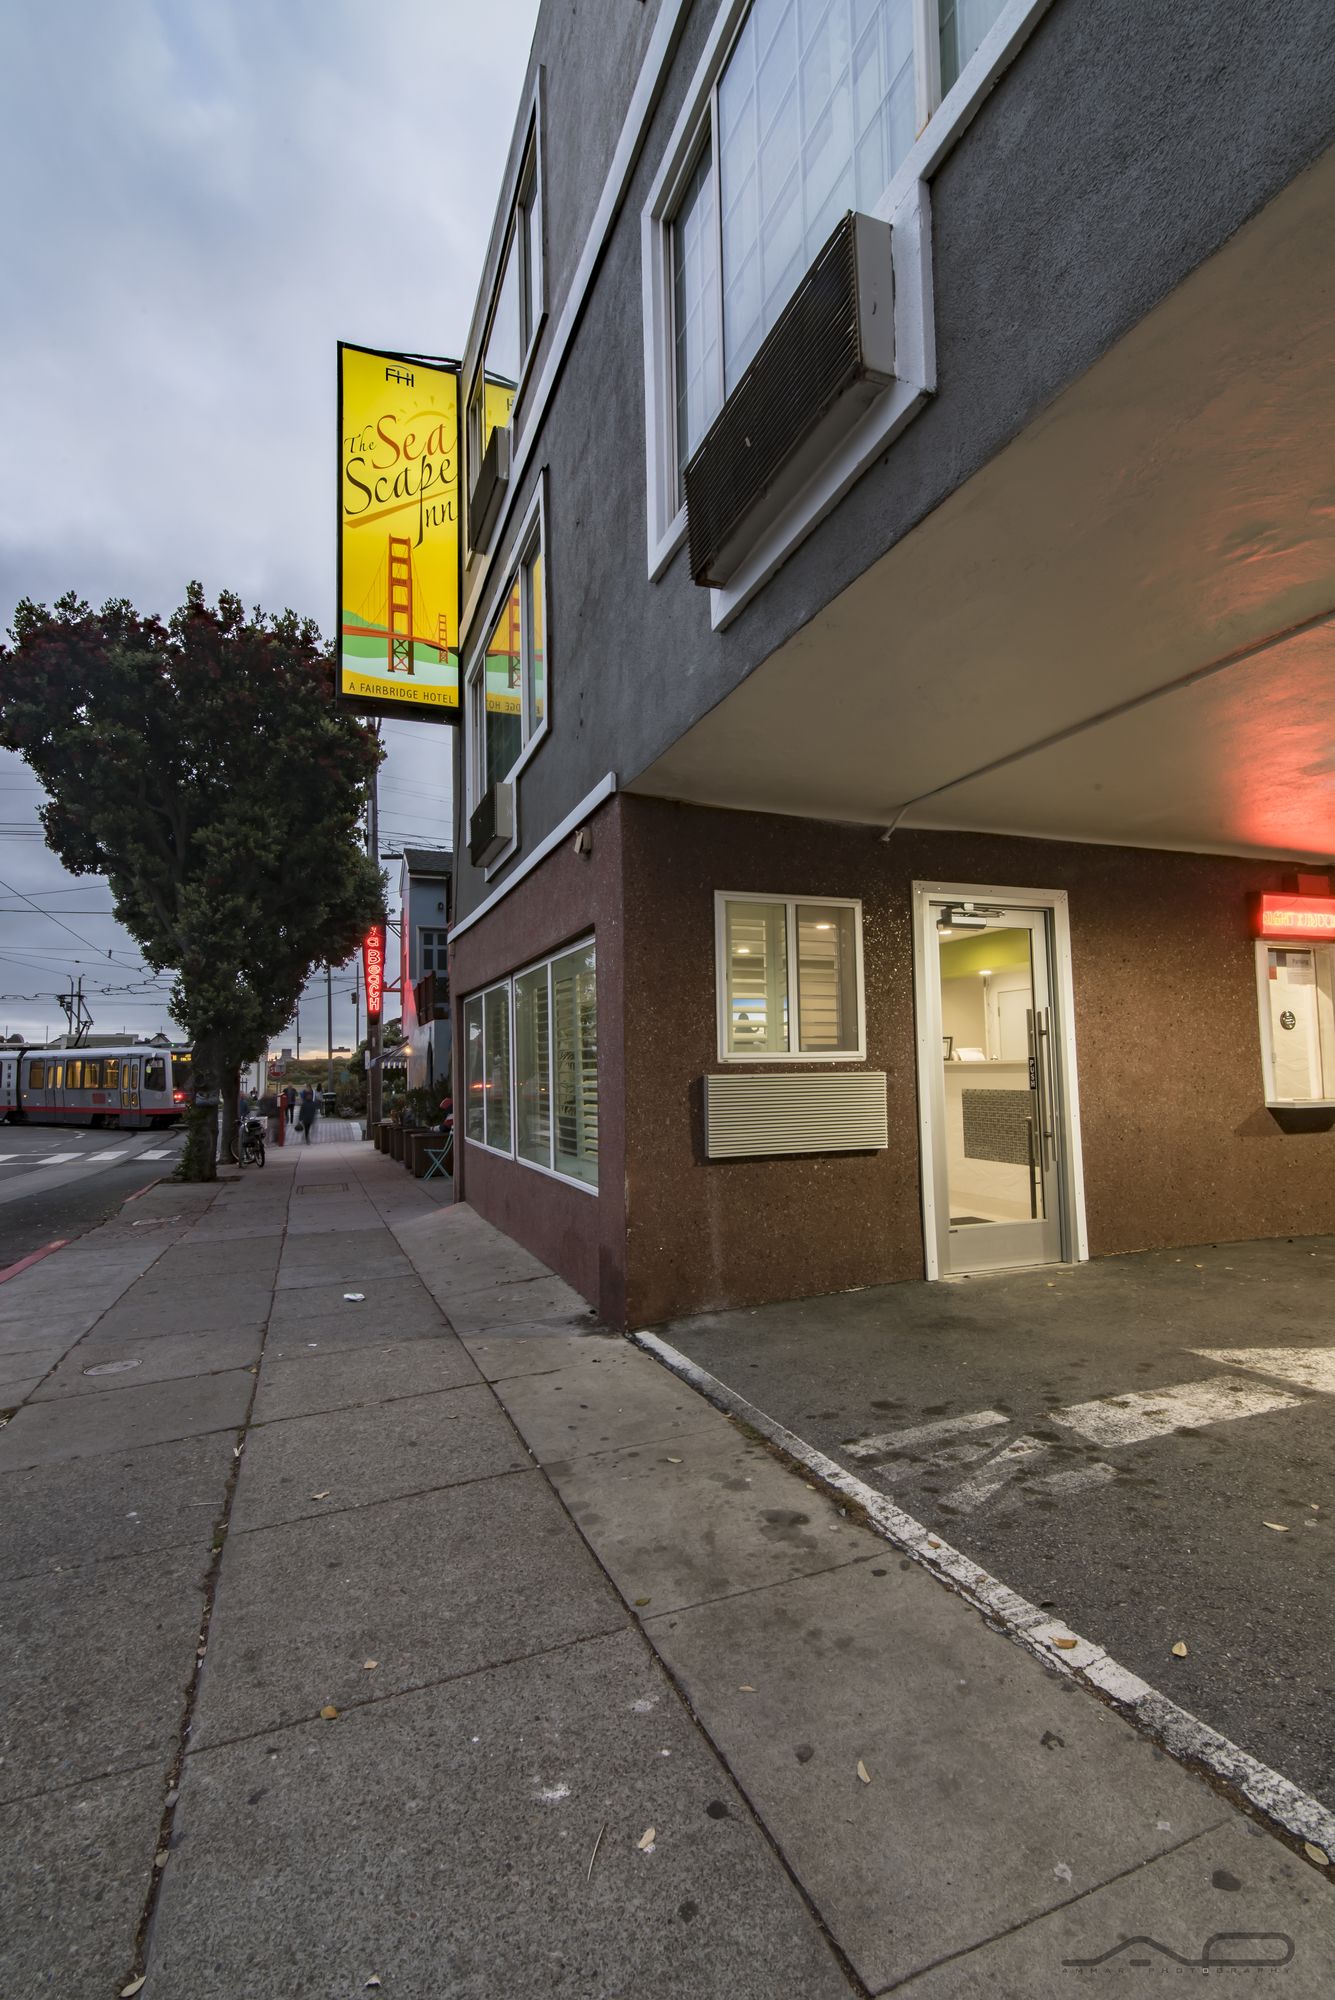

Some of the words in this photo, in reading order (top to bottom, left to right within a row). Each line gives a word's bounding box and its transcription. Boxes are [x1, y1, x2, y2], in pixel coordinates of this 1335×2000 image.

[344, 424, 376, 454] The
[371, 414, 457, 470] Sea
[344, 454, 458, 515] Scape
[349, 681, 356, 691] A
[360, 682, 418, 700] FAIRBRIDGE
[423, 691, 454, 704] HOTEL
